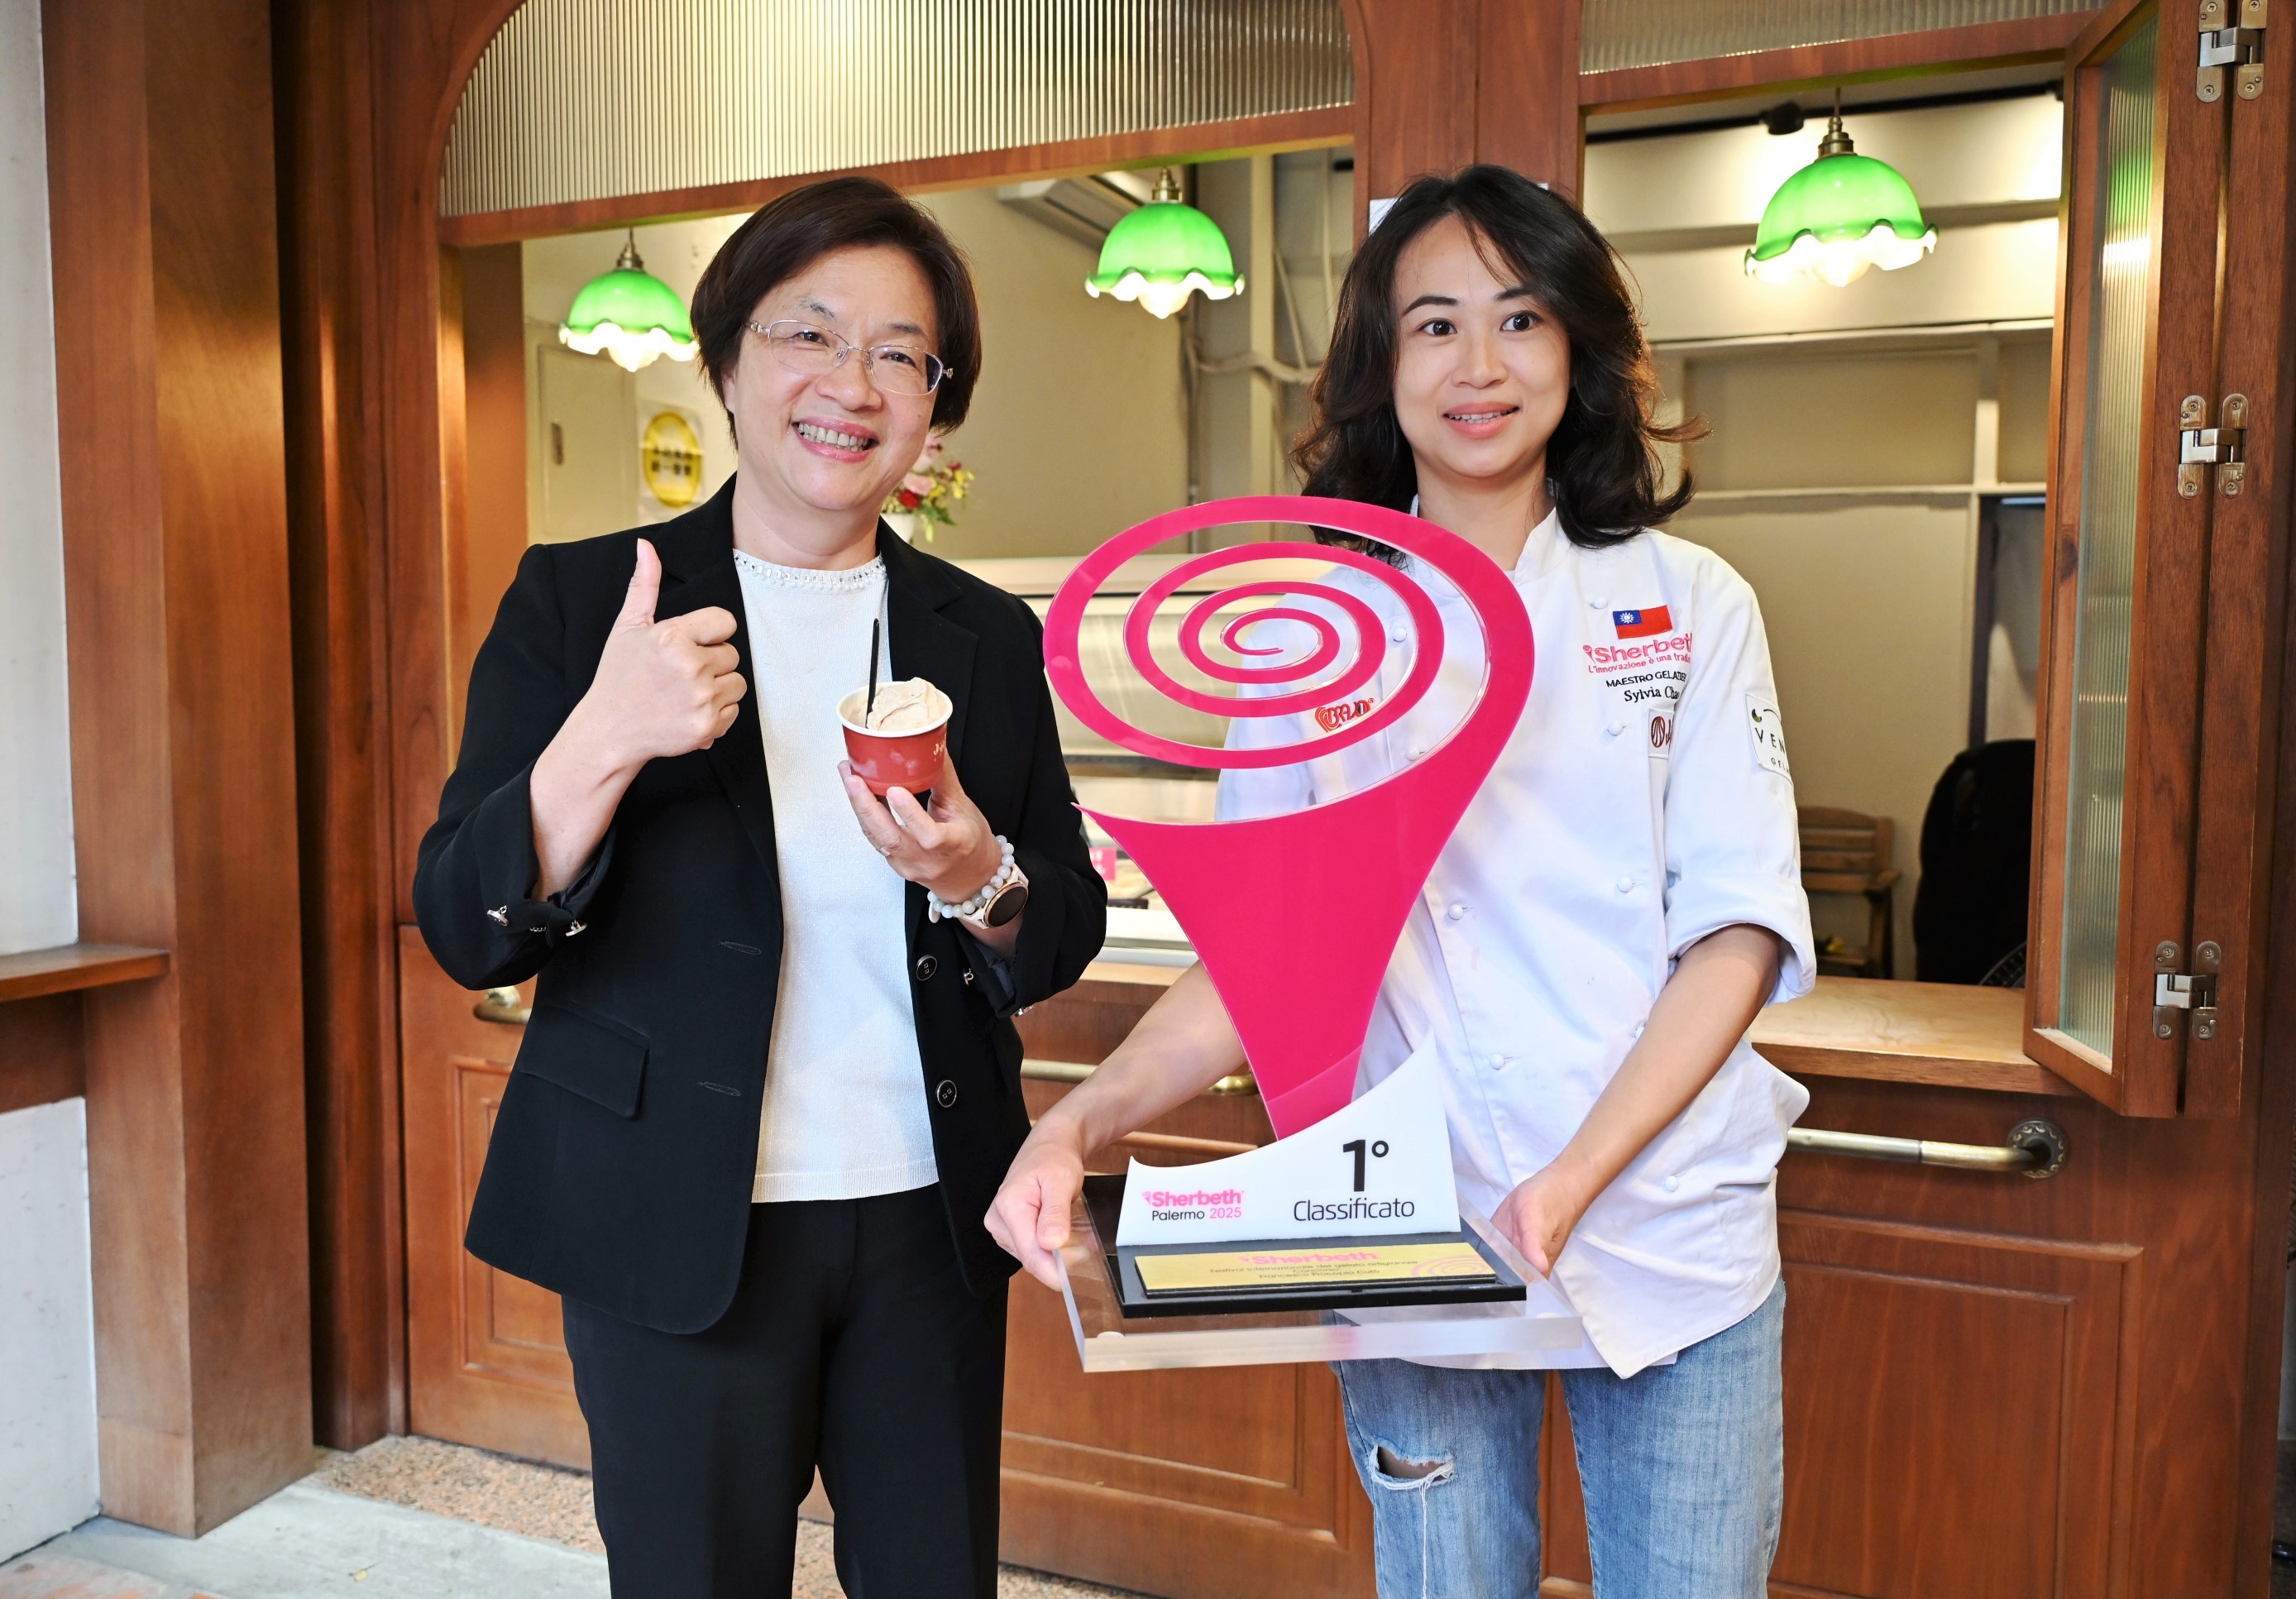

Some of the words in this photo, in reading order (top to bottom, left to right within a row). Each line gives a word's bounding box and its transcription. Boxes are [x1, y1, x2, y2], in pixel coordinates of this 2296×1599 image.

[1656, 654, 1672, 663] una
[1605, 673, 1653, 687] MAESTRO
[1624, 687, 1662, 703] Sylvia
[1151, 1189, 1241, 1207] Sherbeth
[1152, 1210, 1205, 1221] Palermo
[1209, 1207, 1241, 1218] 2025
[1294, 1197, 1415, 1221] Classificato
[1251, 1252, 1378, 1265] Sherbeth
